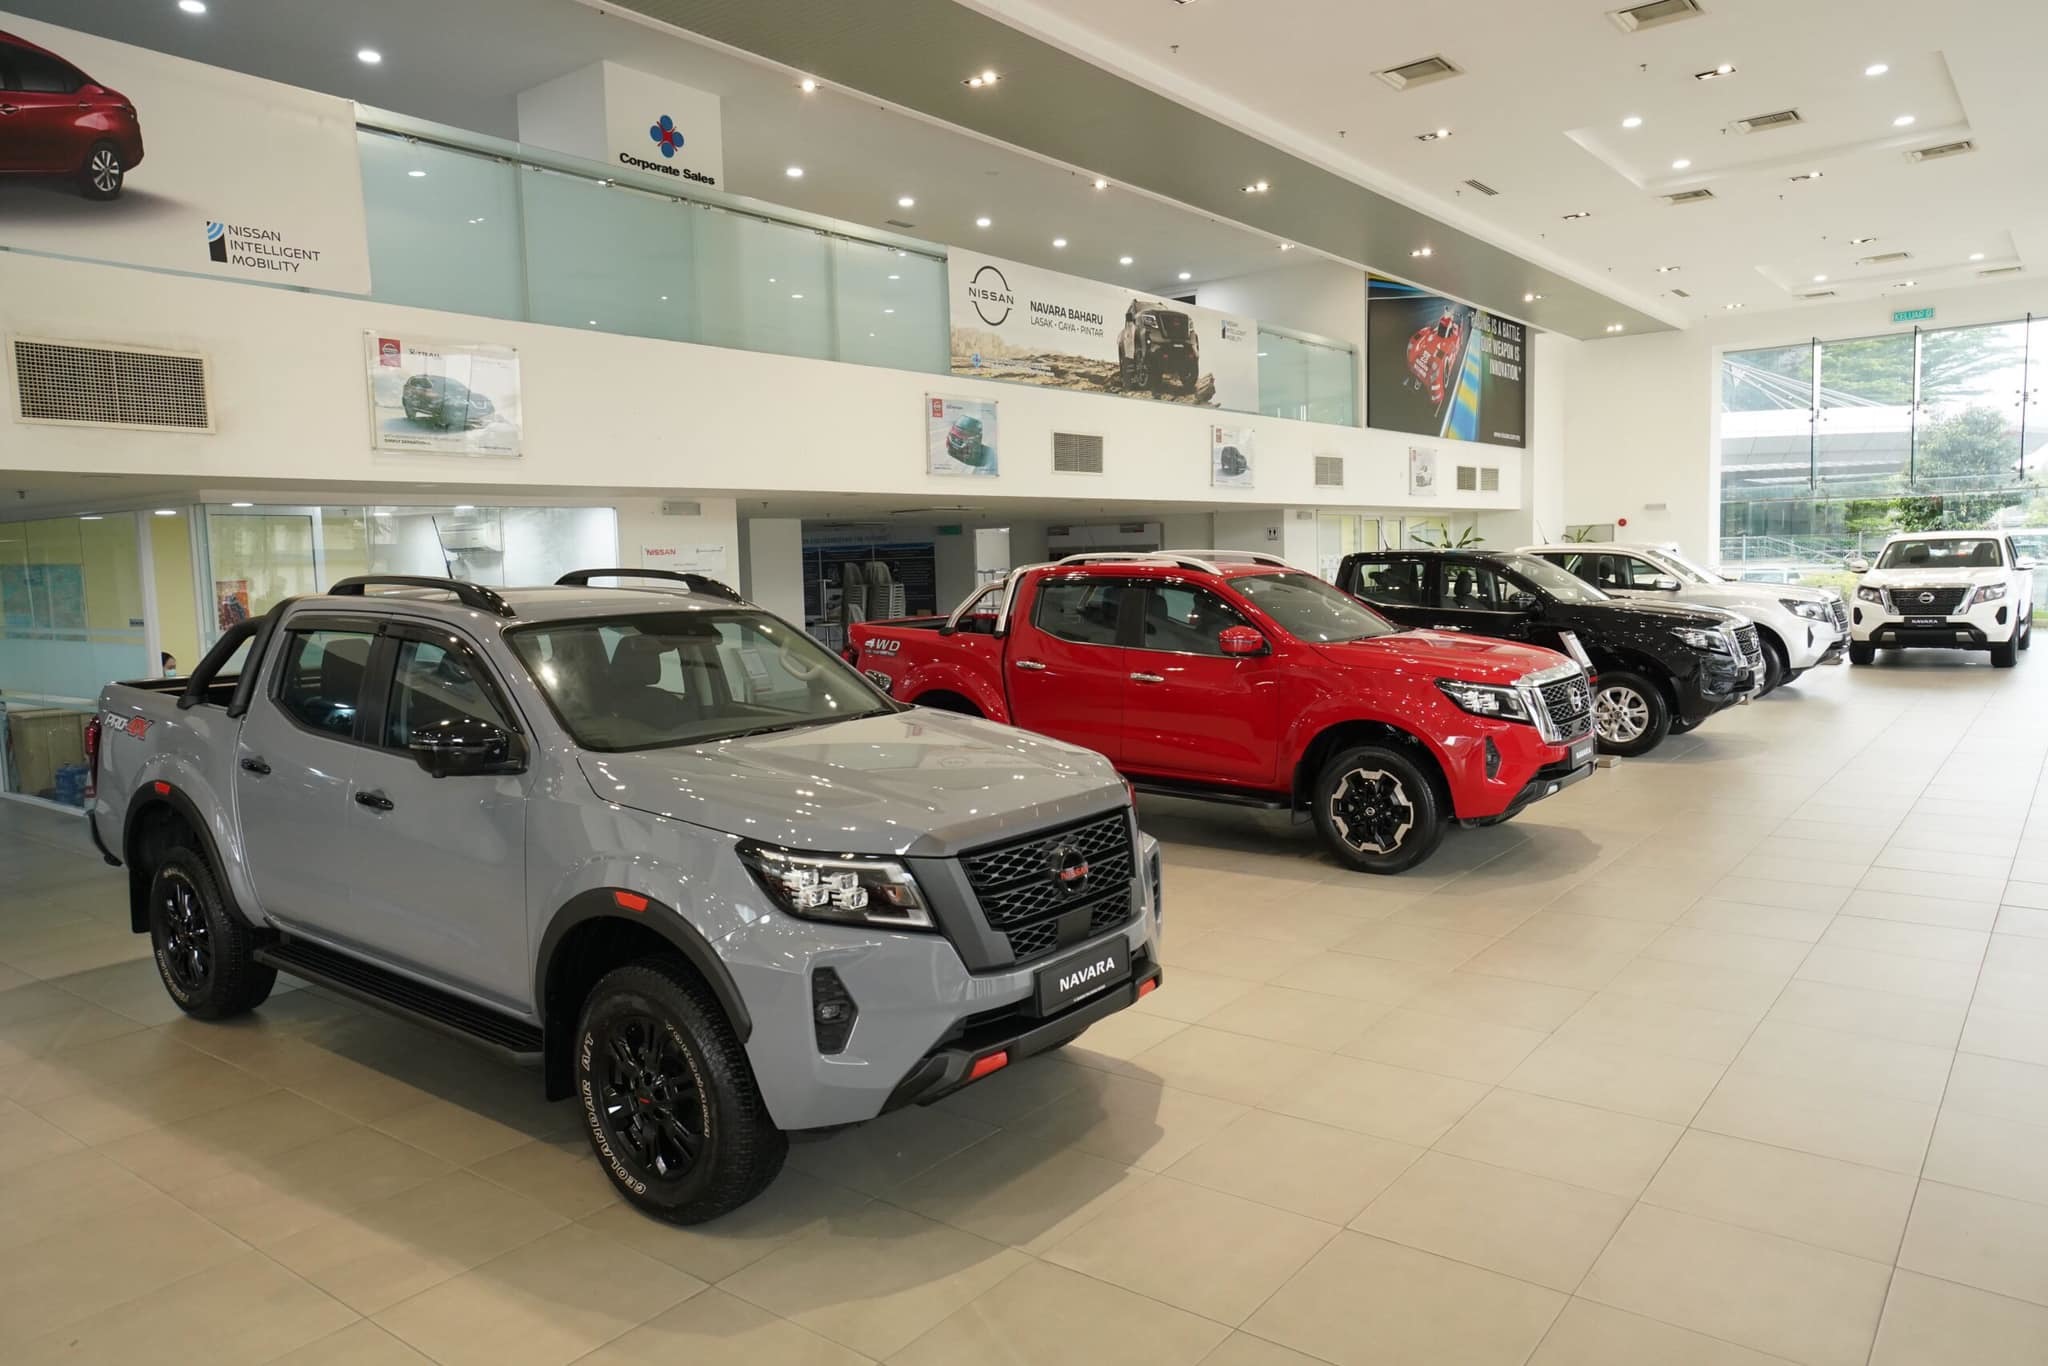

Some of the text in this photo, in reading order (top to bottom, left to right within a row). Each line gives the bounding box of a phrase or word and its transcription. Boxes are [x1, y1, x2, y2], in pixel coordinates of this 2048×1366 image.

[619, 152, 716, 186] Corporate Sales
[228, 224, 281, 242] NISSAN
[230, 239, 321, 261] INTELLIGENT
[232, 254, 300, 272] MOBILITY
[968, 286, 1014, 305] NISSAN
[1030, 300, 1104, 326] NAVARA BAHARU
[1030, 316, 1053, 329] LASAK
[1080, 325, 1104, 338] PINTAR
[645, 547, 677, 557] NISSAN
[864, 638, 901, 652] 4WD
[1060, 861, 1089, 881] NISSAN
[1059, 956, 1116, 993] NAVARA
[580, 1031, 647, 1195] GEOLANDAR A/T
